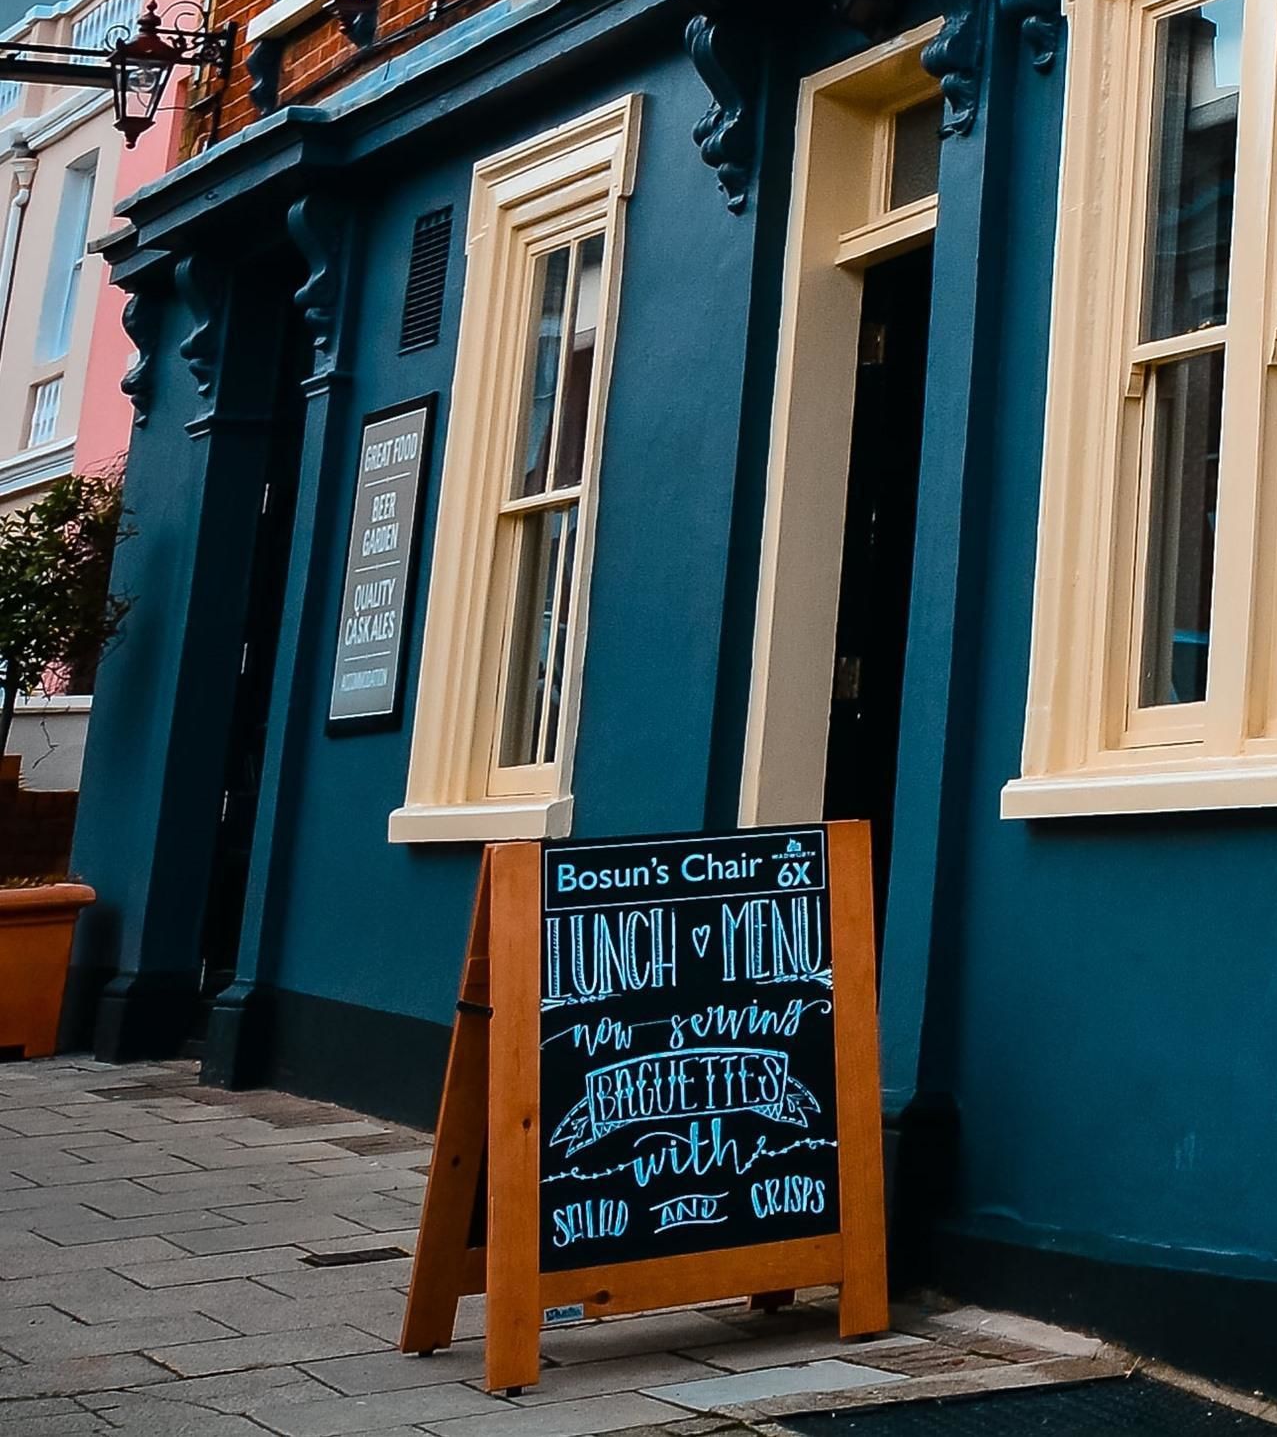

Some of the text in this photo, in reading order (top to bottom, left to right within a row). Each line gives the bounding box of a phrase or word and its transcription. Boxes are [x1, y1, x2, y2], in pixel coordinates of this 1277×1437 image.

[364, 432, 418, 473] GREAT FOOD
[371, 491, 397, 523] BEER
[362, 522, 399, 557] GARDEN
[354, 578, 396, 617] QUALITY
[345, 610, 396, 646] CASK ALES
[557, 852, 763, 893] Bosun's Chair
[777, 861, 812, 887] 6X
[545, 895, 823, 998] LUNCH MENU
[572, 998, 806, 1057] now serving
[596, 1054, 782, 1120] BAGUETTES
[633, 1117, 744, 1187] with
[552, 1174, 826, 1248] SALAD AND CRISPS
